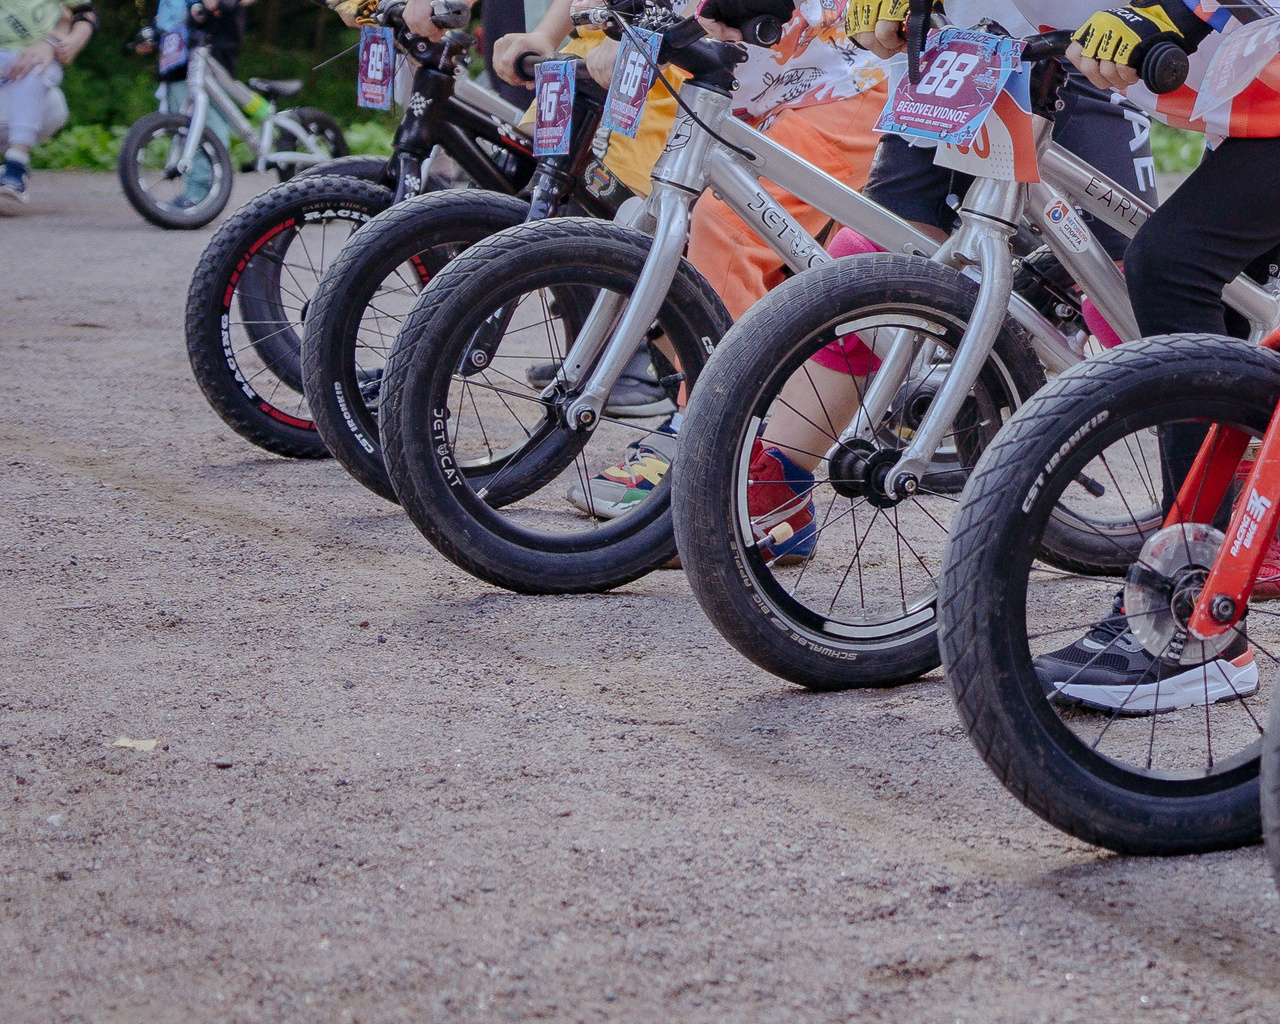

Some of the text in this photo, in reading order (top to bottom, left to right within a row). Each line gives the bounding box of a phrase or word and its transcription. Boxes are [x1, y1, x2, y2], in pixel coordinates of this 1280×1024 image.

[368, 43, 386, 81] 89
[619, 50, 646, 98] 66
[916, 50, 979, 98] 88
[896, 100, 970, 124] BEGOVELVIDNOE
[1084, 176, 1138, 227] EARL
[1063, 224, 1083, 245] СПОРТА
[334, 381, 358, 432] IRONKID
[1021, 409, 1110, 514] CST IRONKID
[1230, 513, 1251, 558] RACING
[1242, 520, 1258, 549] BIKE
[729, 541, 858, 660] SCHWALBE BIG APPLE
